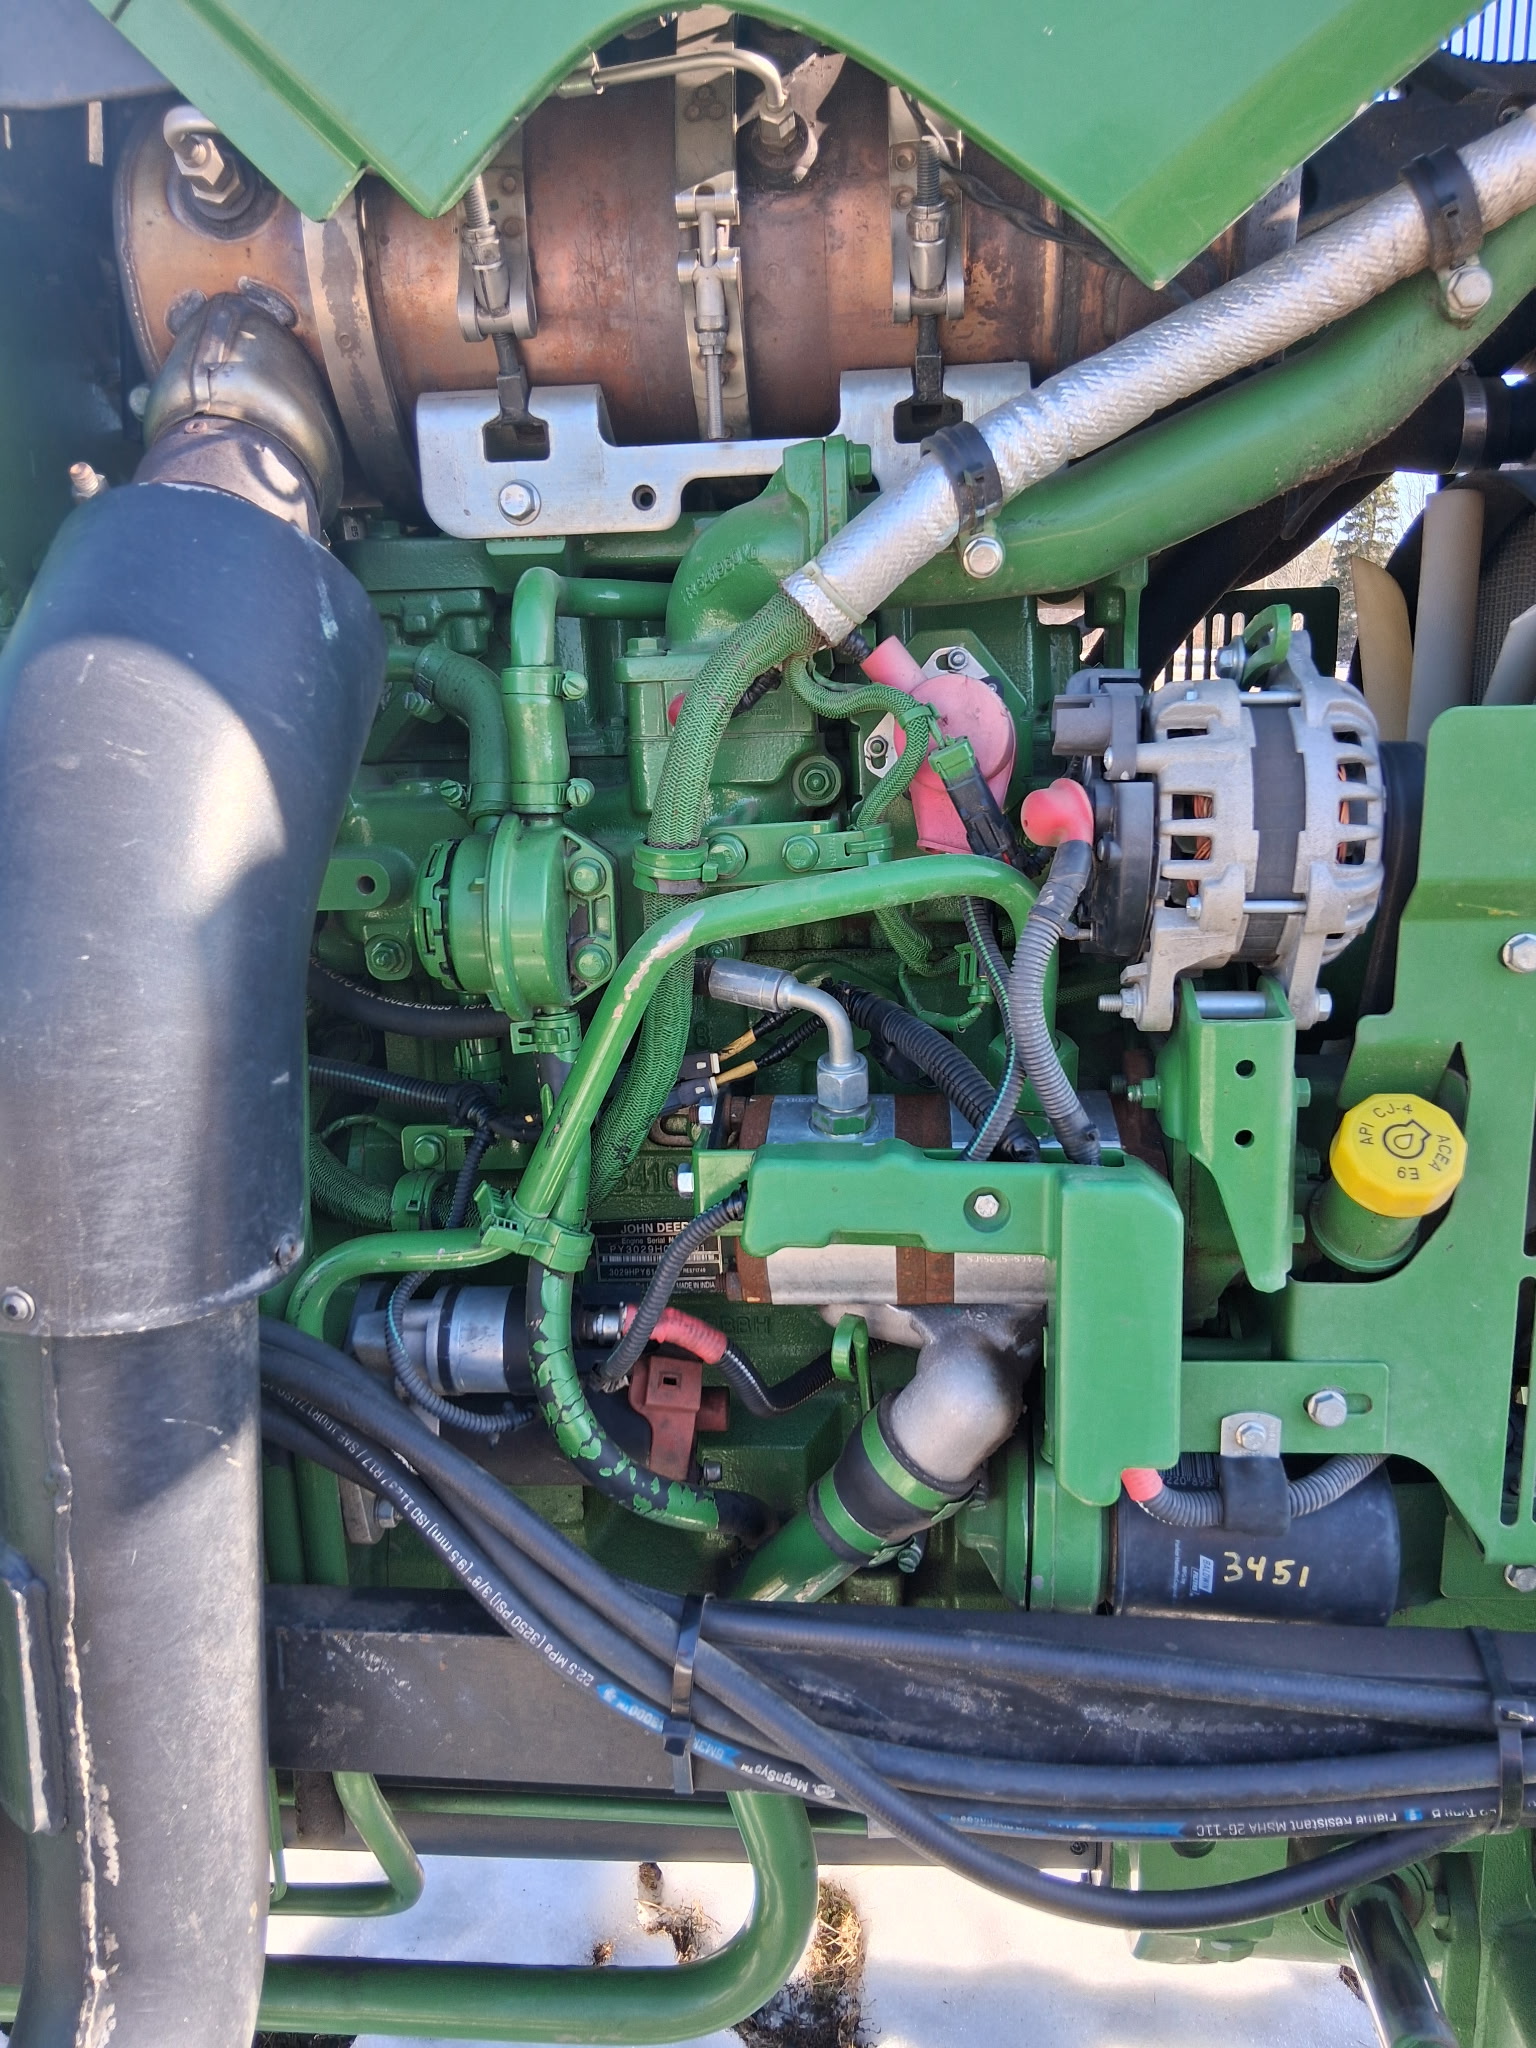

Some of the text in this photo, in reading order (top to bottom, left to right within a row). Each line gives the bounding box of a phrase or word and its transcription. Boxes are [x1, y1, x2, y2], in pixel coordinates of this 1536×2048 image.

[1359, 1103, 1413, 1145] API CJ-4
[1427, 1134, 1452, 1172] ACEA
[620, 1223, 654, 1234] JOHN
[621, 1237, 644, 1246] Engine
[646, 1236, 665, 1244] Serial
[676, 1280, 716, 1290] MADE IN INDIA
[337, 1434, 360, 1454] SAE
[361, 1457, 385, 1479] R17
[410, 1506, 431, 1530] ISO
[1223, 1551, 1310, 1588] 3451
[544, 1642, 568, 1668] MPa
[568, 1661, 595, 1687] 22.5
[1248, 1820, 1288, 1834] MSHA
[1290, 1814, 1352, 1832] Resistant
